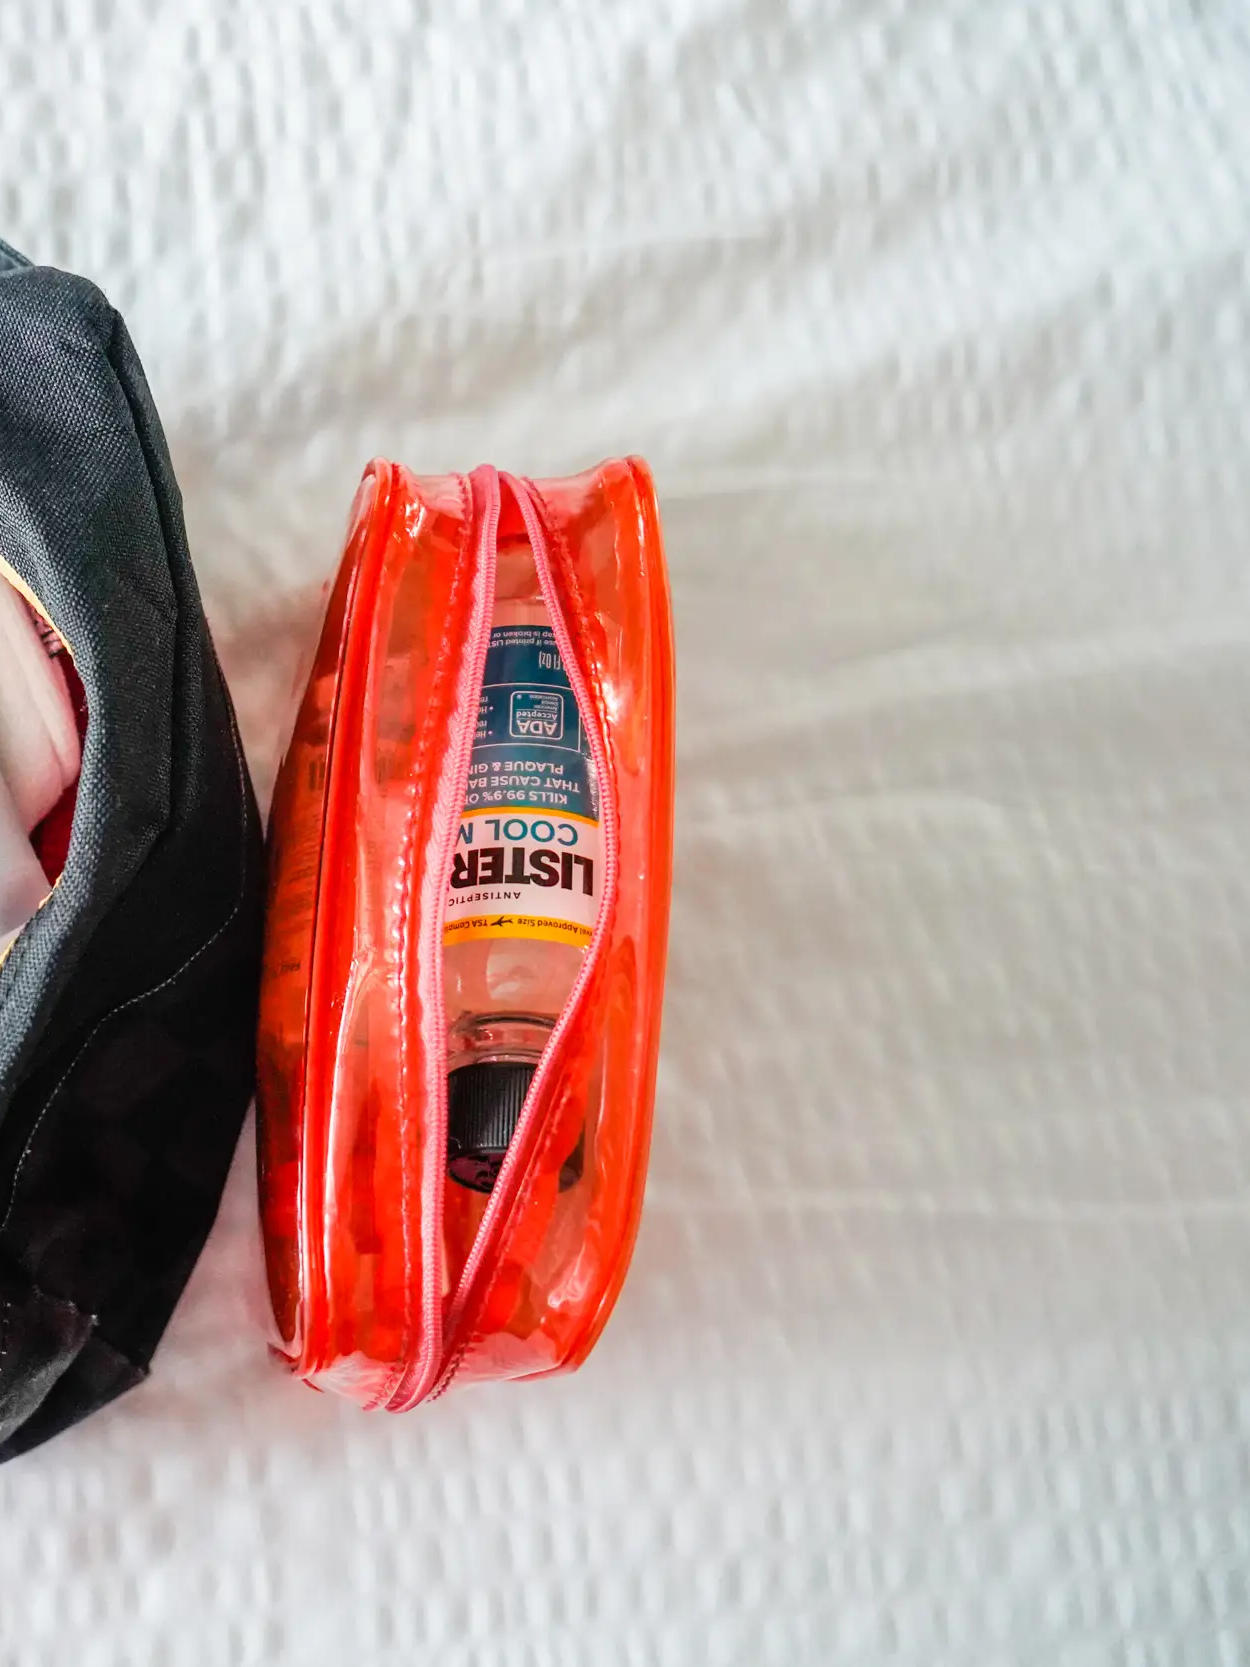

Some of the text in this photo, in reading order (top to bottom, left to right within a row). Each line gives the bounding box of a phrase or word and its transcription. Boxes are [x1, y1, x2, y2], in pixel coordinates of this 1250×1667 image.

[505, 637, 534, 646] printed
[516, 710, 558, 720] Accepted
[516, 720, 558, 735] ADA
[492, 762, 501, 772] &
[504, 761, 564, 775] PLAQUE
[490, 775, 540, 787] CAUSE
[544, 778, 580, 793] THAT
[482, 790, 525, 801] 99.9%
[529, 790, 568, 805] KILLS
[485, 819, 578, 846] COOL
[450, 847, 594, 896] LISTER
[448, 892, 521, 906] ANTISEPTIC
[472, 919, 488, 928] TSA
[517, 918, 535, 927] Size
[538, 920, 578, 934] Approved
